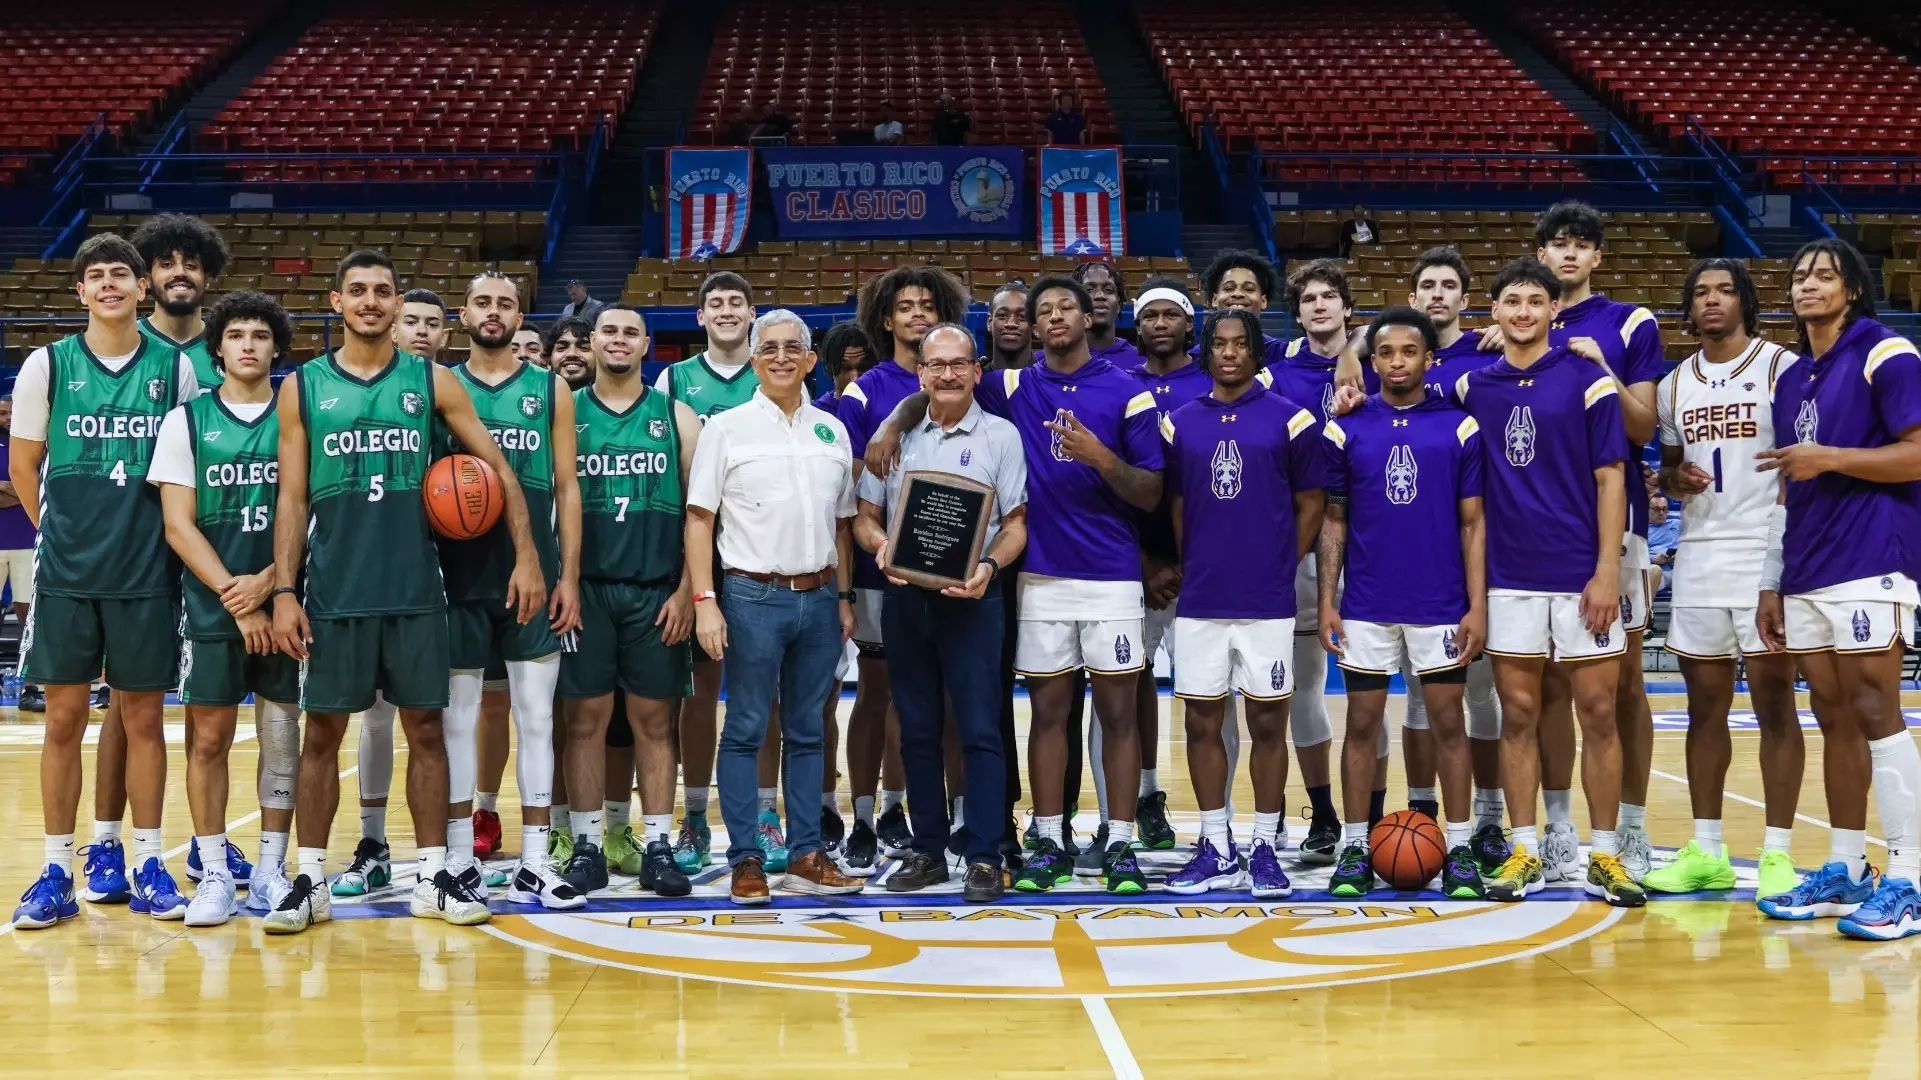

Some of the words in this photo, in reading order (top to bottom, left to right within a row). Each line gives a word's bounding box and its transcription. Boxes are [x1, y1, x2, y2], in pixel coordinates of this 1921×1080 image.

[668, 167, 720, 202] PUERTO
[767, 162, 875, 188] PUERTO
[882, 161, 943, 186] RICO
[1040, 166, 1090, 199] PUERTO
[1093, 171, 1121, 199] RICO
[1682, 402, 1757, 427] GREAT
[323, 428, 420, 457] COLEGIO
[1683, 421, 1757, 445] DANES
[109, 460, 127, 486] 4
[206, 461, 279, 487] COLEG
[576, 452, 668, 477] COLEGIO
[1712, 447, 1723, 493] 1
[367, 473, 385, 502] 5
[464, 489, 483, 517] THE
[614, 496, 630, 522] 7
[240, 505, 268, 532] 15
[627, 912, 784, 928] DE
[879, 905, 1440, 923] BAYAMON
